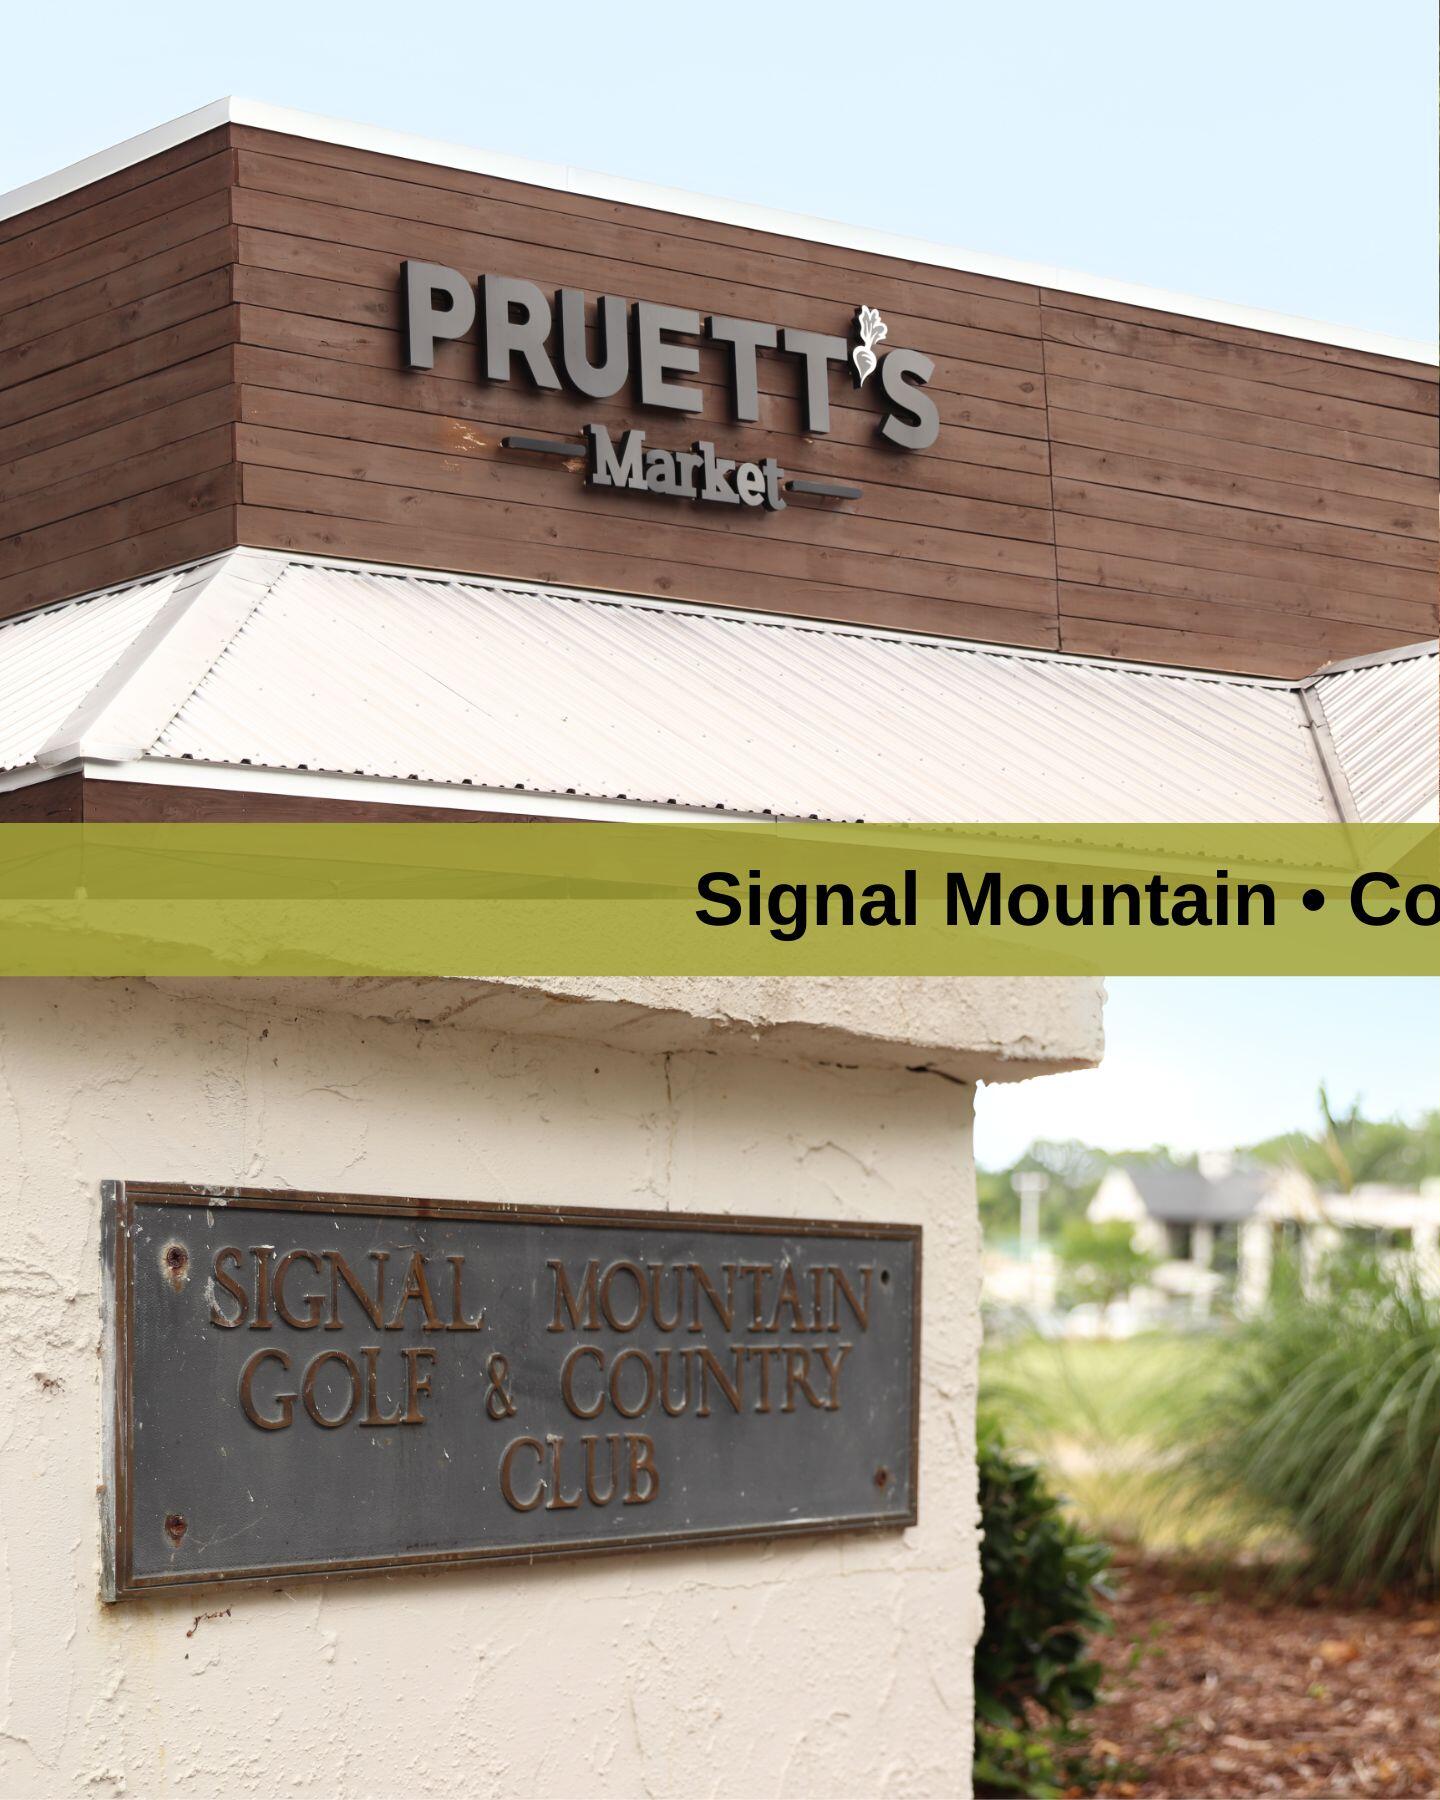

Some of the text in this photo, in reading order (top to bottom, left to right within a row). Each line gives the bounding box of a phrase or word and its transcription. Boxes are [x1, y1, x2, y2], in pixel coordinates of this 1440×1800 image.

[583, 423, 786, 511] Market
[209, 1245, 875, 1333] SIGNAL MOUNTAIN
[239, 1343, 851, 1431] GOLF & COUNTRY
[500, 1433, 660, 1513] CLUB
